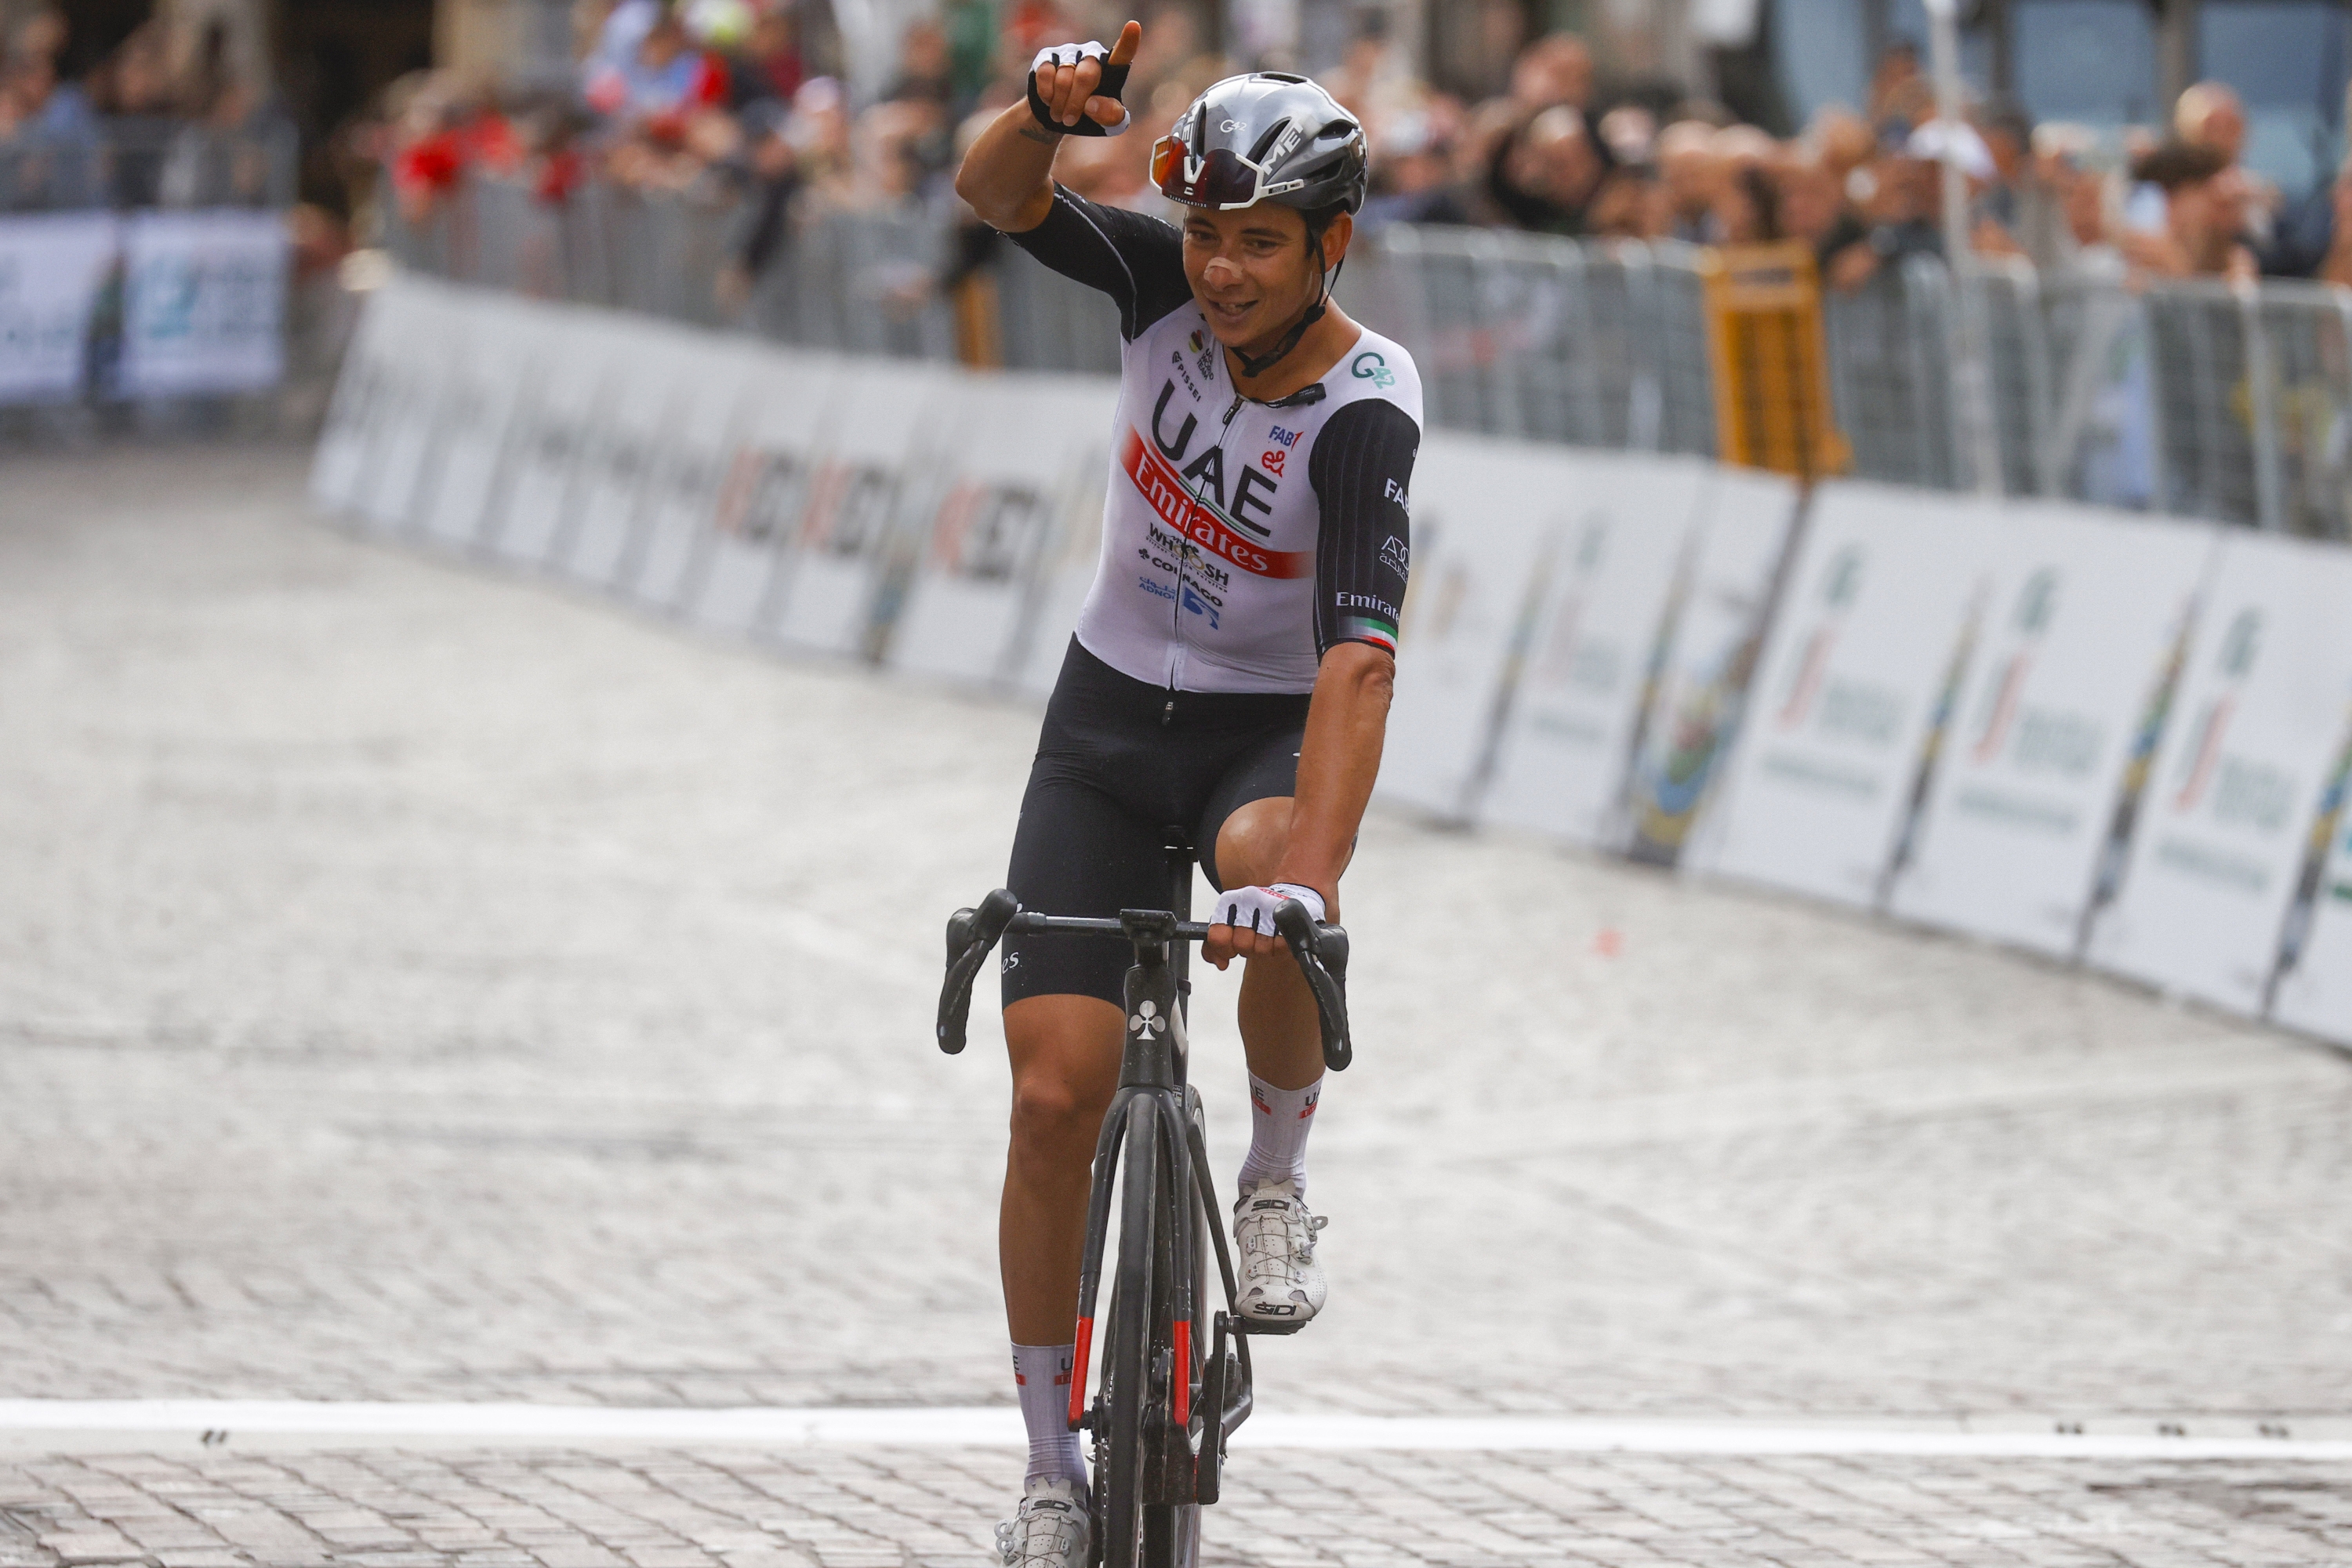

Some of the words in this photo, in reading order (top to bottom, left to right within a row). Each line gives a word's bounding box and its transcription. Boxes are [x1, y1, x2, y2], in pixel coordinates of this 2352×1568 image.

[1220, 119, 1247, 133] G42
[1261, 120, 1303, 176] MET
[1177, 364, 1202, 402] PISSEI
[1352, 352, 1396, 389] G42
[1152, 378, 1277, 537] UAE
[1136, 451, 1268, 572] Emirates
[1336, 591, 1399, 626] Emirate
